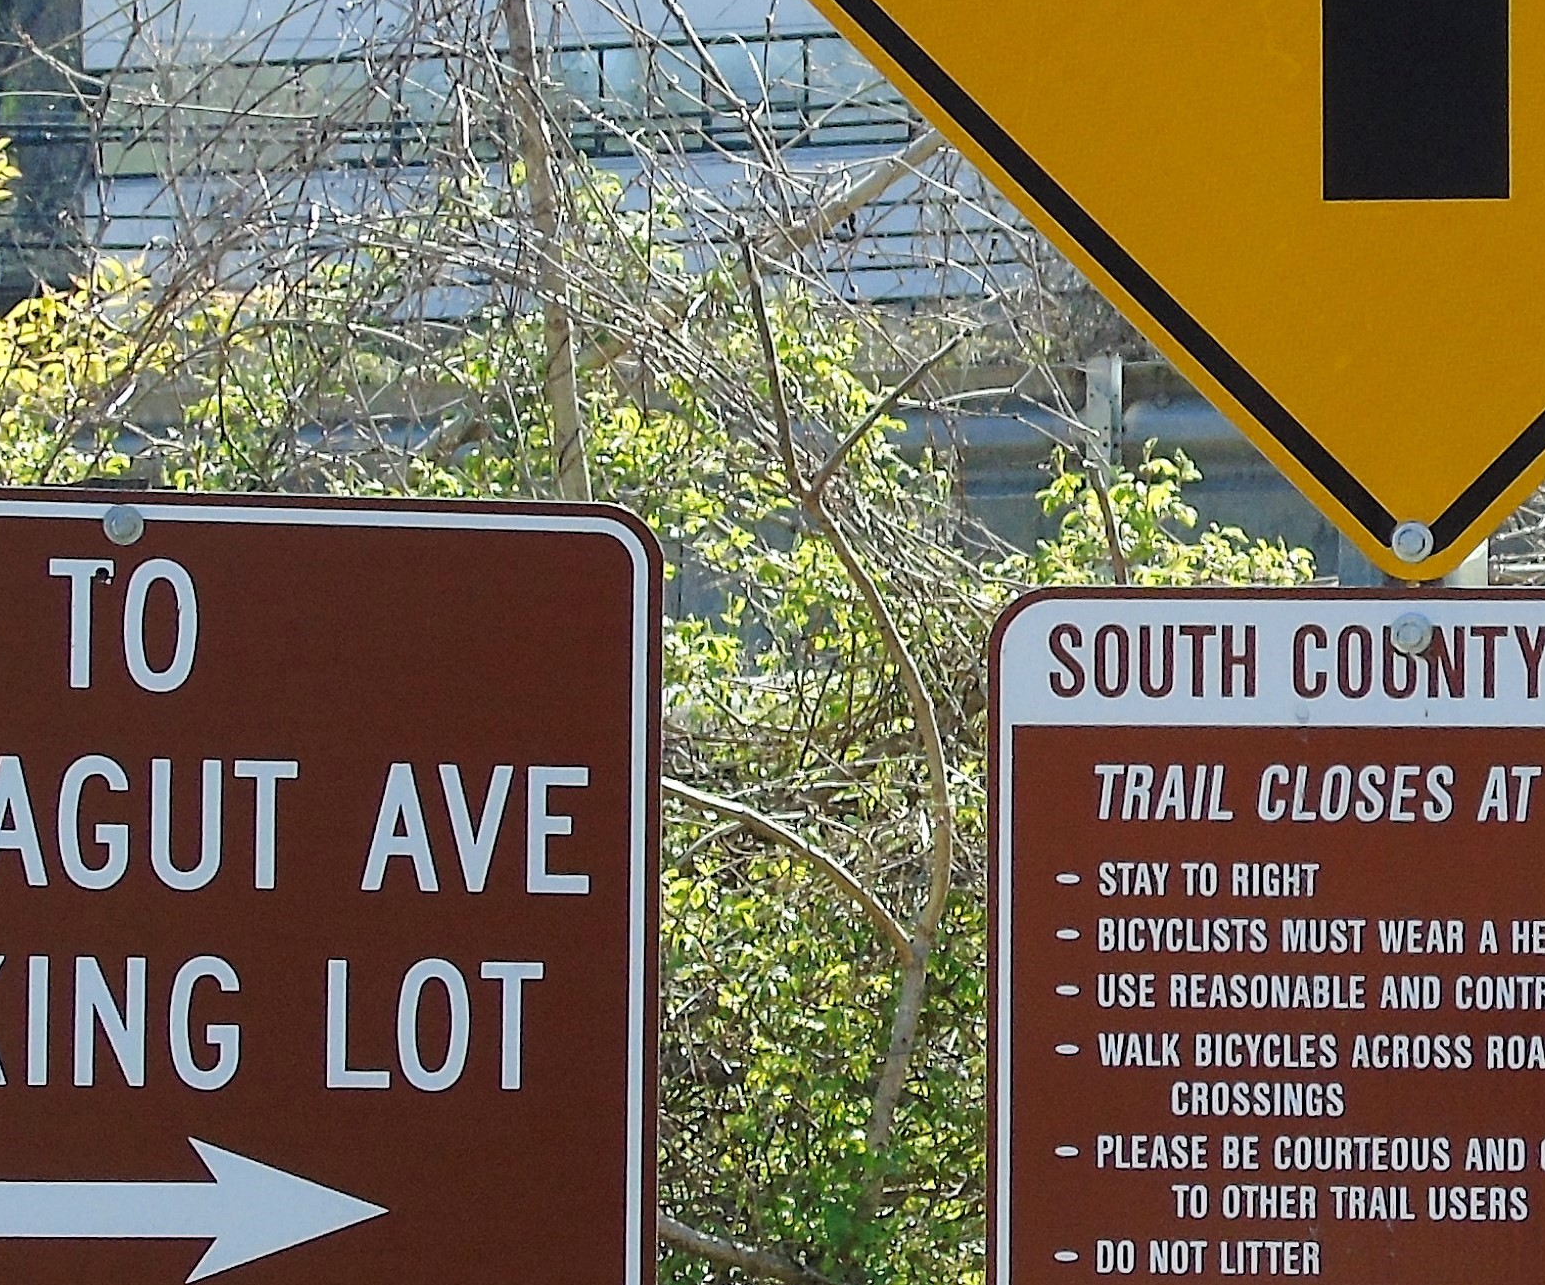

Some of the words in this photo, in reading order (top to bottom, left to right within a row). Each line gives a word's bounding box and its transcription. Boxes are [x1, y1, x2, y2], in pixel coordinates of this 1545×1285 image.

[48, 558, 198, 693] TO
[1048, 623, 1256, 699] SOUTH
[1094, 764, 1234, 821] TRAIL
[1257, 764, 1454, 822] CLOSES
[1477, 765, 1542, 822] AT
[360, 762, 590, 895] AVE
[1098, 861, 1169, 896] STAY
[1180, 862, 1218, 897] TO
[1232, 862, 1320, 897] RIGHT
[1098, 917, 1268, 953] BICYCLISTS
[1282, 918, 1367, 954] MUST
[1378, 919, 1464, 954] WEAR
[1479, 920, 1498, 954] A
[1097, 973, 1156, 1008] USE
[1170, 974, 1366, 1009] REASONABLE
[1380, 975, 1441, 1010] AND
[326, 958, 544, 1092] LOT
[1098, 1032, 1181, 1067] WALK
[1195, 1033, 1337, 1068] BICYCLES
[1351, 1034, 1472, 1069] ACROSS
[1171, 1081, 1344, 1117] CROSSINGS
[1097, 1134, 1208, 1170] PLEASE
[1222, 1135, 1259, 1170] BE
[1274, 1135, 1450, 1171] COURTEOUS
[1464, 1137, 1526, 1172] AND
[1171, 1184, 1208, 1219] TO
[1222, 1184, 1317, 1219] OTHER
[1329, 1185, 1416, 1220] TRAIL
[1428, 1186, 1528, 1221] USERS
[1096, 1239, 1135, 1274] DO
[1149, 1240, 1208, 1275] NOT
[1220, 1240, 1320, 1275] LITTER
